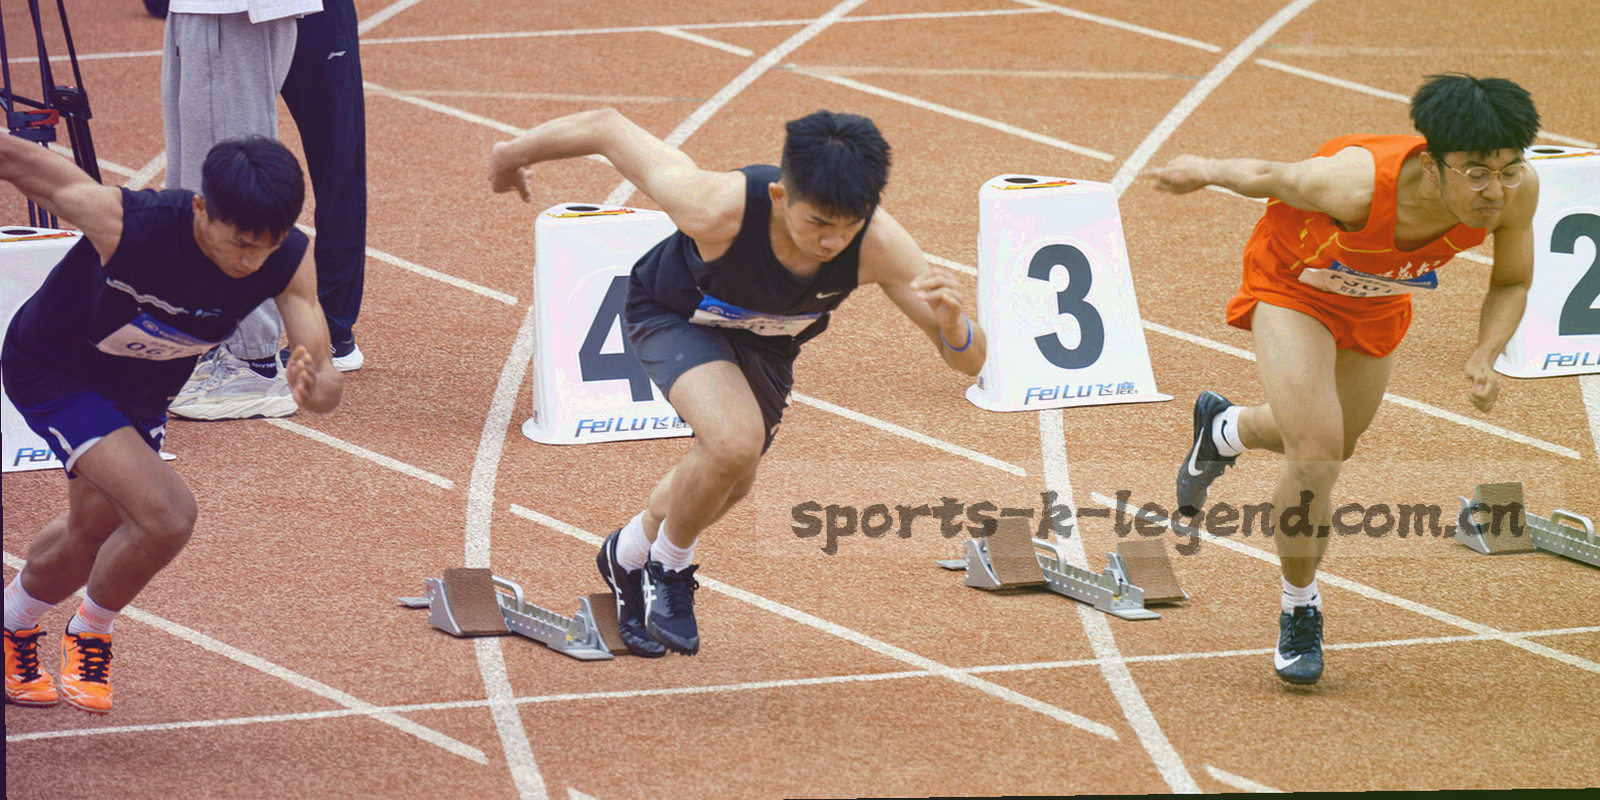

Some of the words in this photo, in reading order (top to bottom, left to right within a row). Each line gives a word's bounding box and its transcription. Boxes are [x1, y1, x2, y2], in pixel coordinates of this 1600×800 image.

[1027, 244, 1105, 369] 3
[1550, 213, 1600, 336] 2
[578, 275, 654, 402] 4
[1542, 352, 1600, 370] FeiL
[13, 447, 59, 466] Fei
